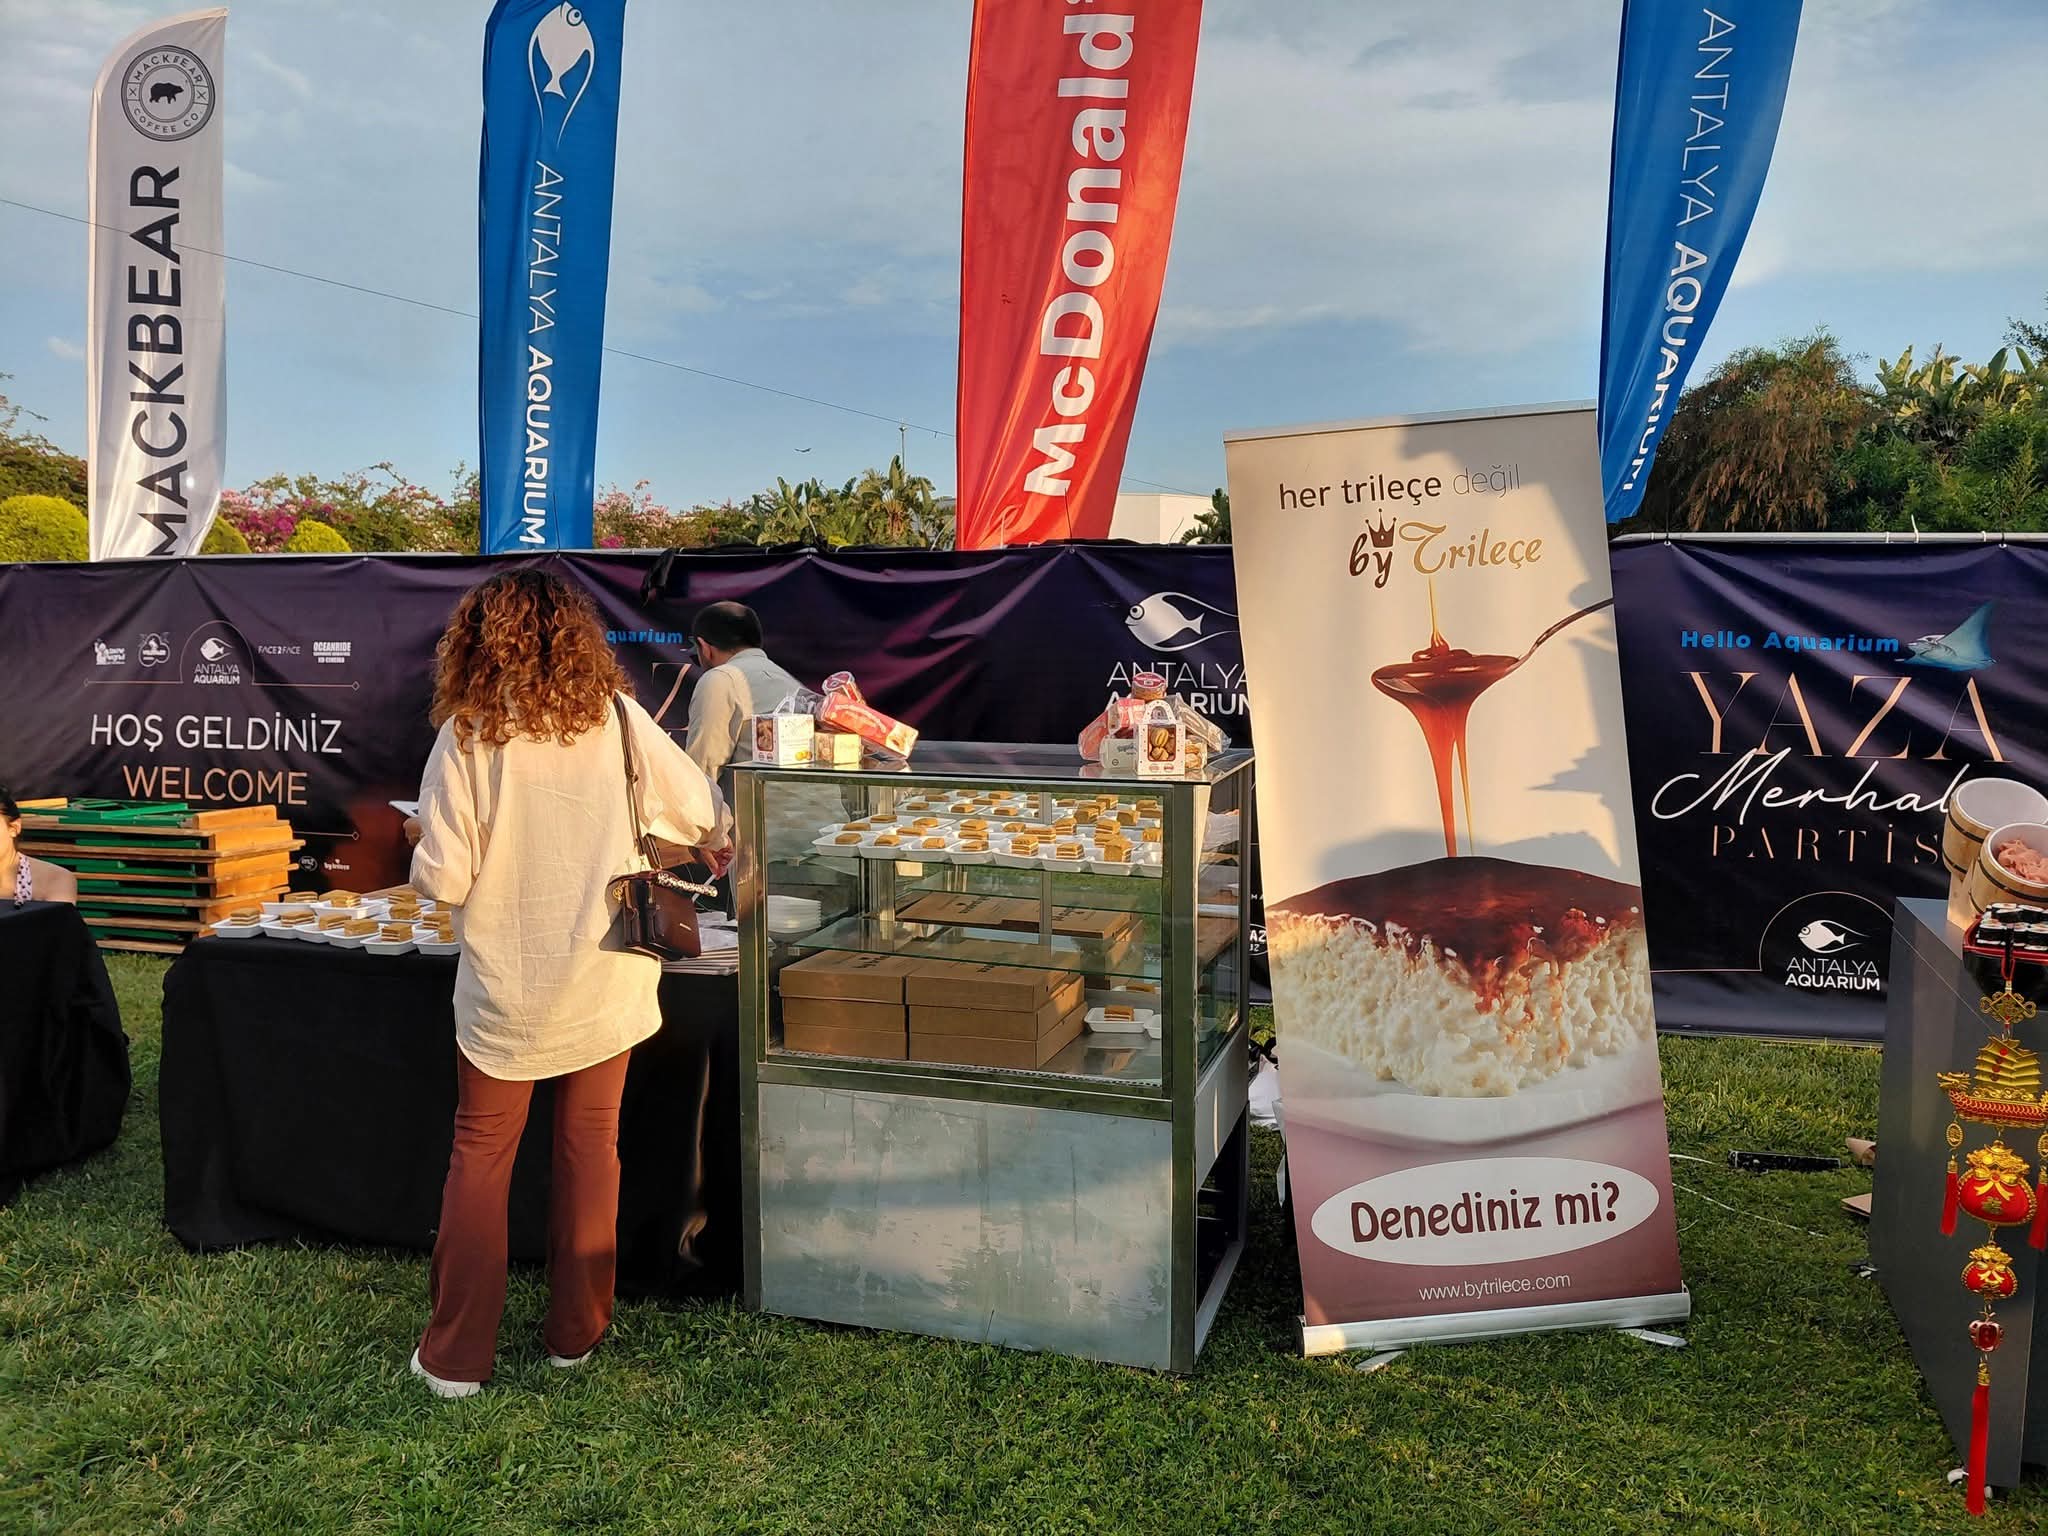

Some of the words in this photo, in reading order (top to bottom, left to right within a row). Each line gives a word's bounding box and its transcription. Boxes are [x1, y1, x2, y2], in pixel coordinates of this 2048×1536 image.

[133, 54, 203, 83] MACKBEAR
[133, 108, 177, 133] COFFEE
[1676, 7, 1737, 228] ANTALYA
[528, 160, 564, 335] ANTALYA
[1023, 0, 1135, 496] McDonald
[127, 165, 188, 556] MACKBEAR
[520, 344, 554, 545] AQUARIUM
[1279, 483, 1331, 510] her
[1341, 473, 1442, 506] trileçe
[1452, 462, 1521, 499] değil
[1349, 531, 1394, 589] by
[1399, 520, 1544, 575] Trileçe
[606, 628, 684, 645] quarium
[1681, 630, 1751, 649] Hello
[1763, 632, 1899, 653] Aquarium
[193, 674, 241, 685] AQUARIUM
[194, 663, 240, 675] ANTALYA
[90, 713, 164, 752] HOŞ
[175, 711, 343, 754] GELDİNİZ
[1680, 671, 2015, 764] YAZA
[122, 765, 308, 806] WELCOME
[1784, 973, 1881, 992] AQUARIUM
[1786, 957, 1880, 977] ANTALYA
[1350, 1188, 1542, 1243] Denediniz
[1555, 1180, 1620, 1227] mi?
[1418, 1272, 1571, 1301] www.bytrilece.com
